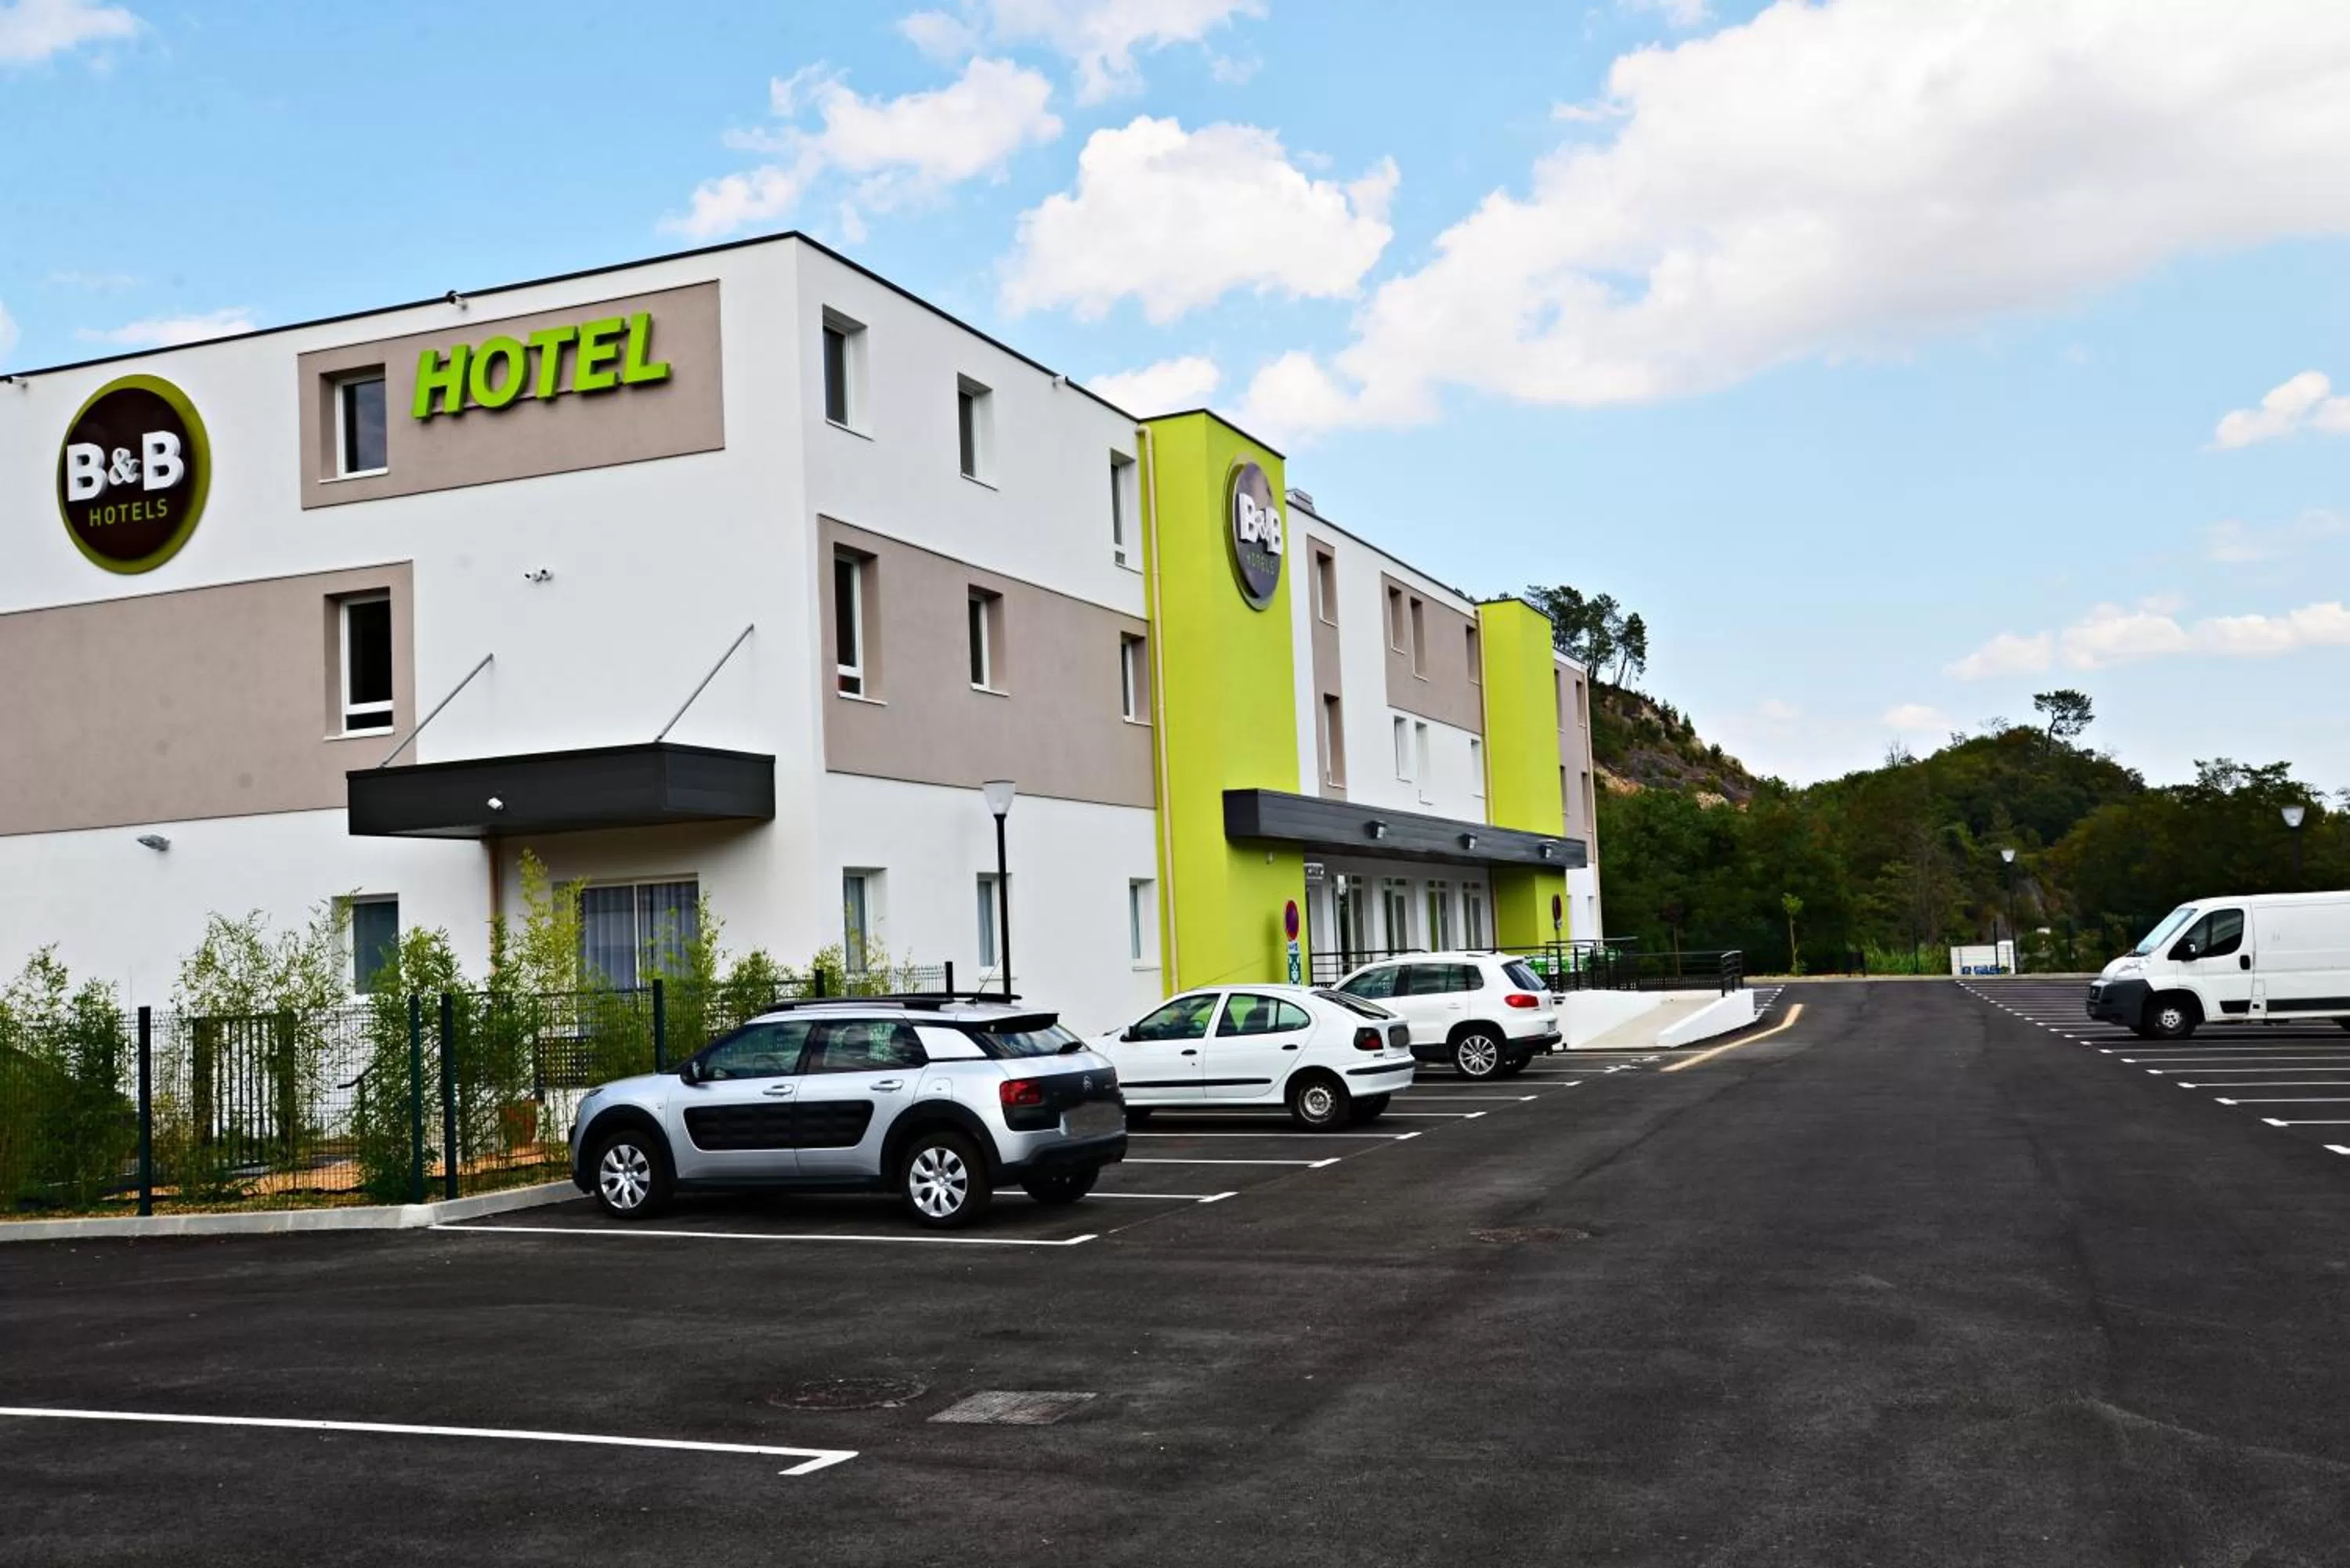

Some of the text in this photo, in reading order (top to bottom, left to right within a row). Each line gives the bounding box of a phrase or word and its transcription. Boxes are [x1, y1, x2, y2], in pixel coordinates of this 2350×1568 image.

[411, 313, 671, 420] HOTEL
[67, 430, 184, 501] B&B
[89, 498, 168, 527] HOTELS
[1238, 492, 1284, 555] B&B
